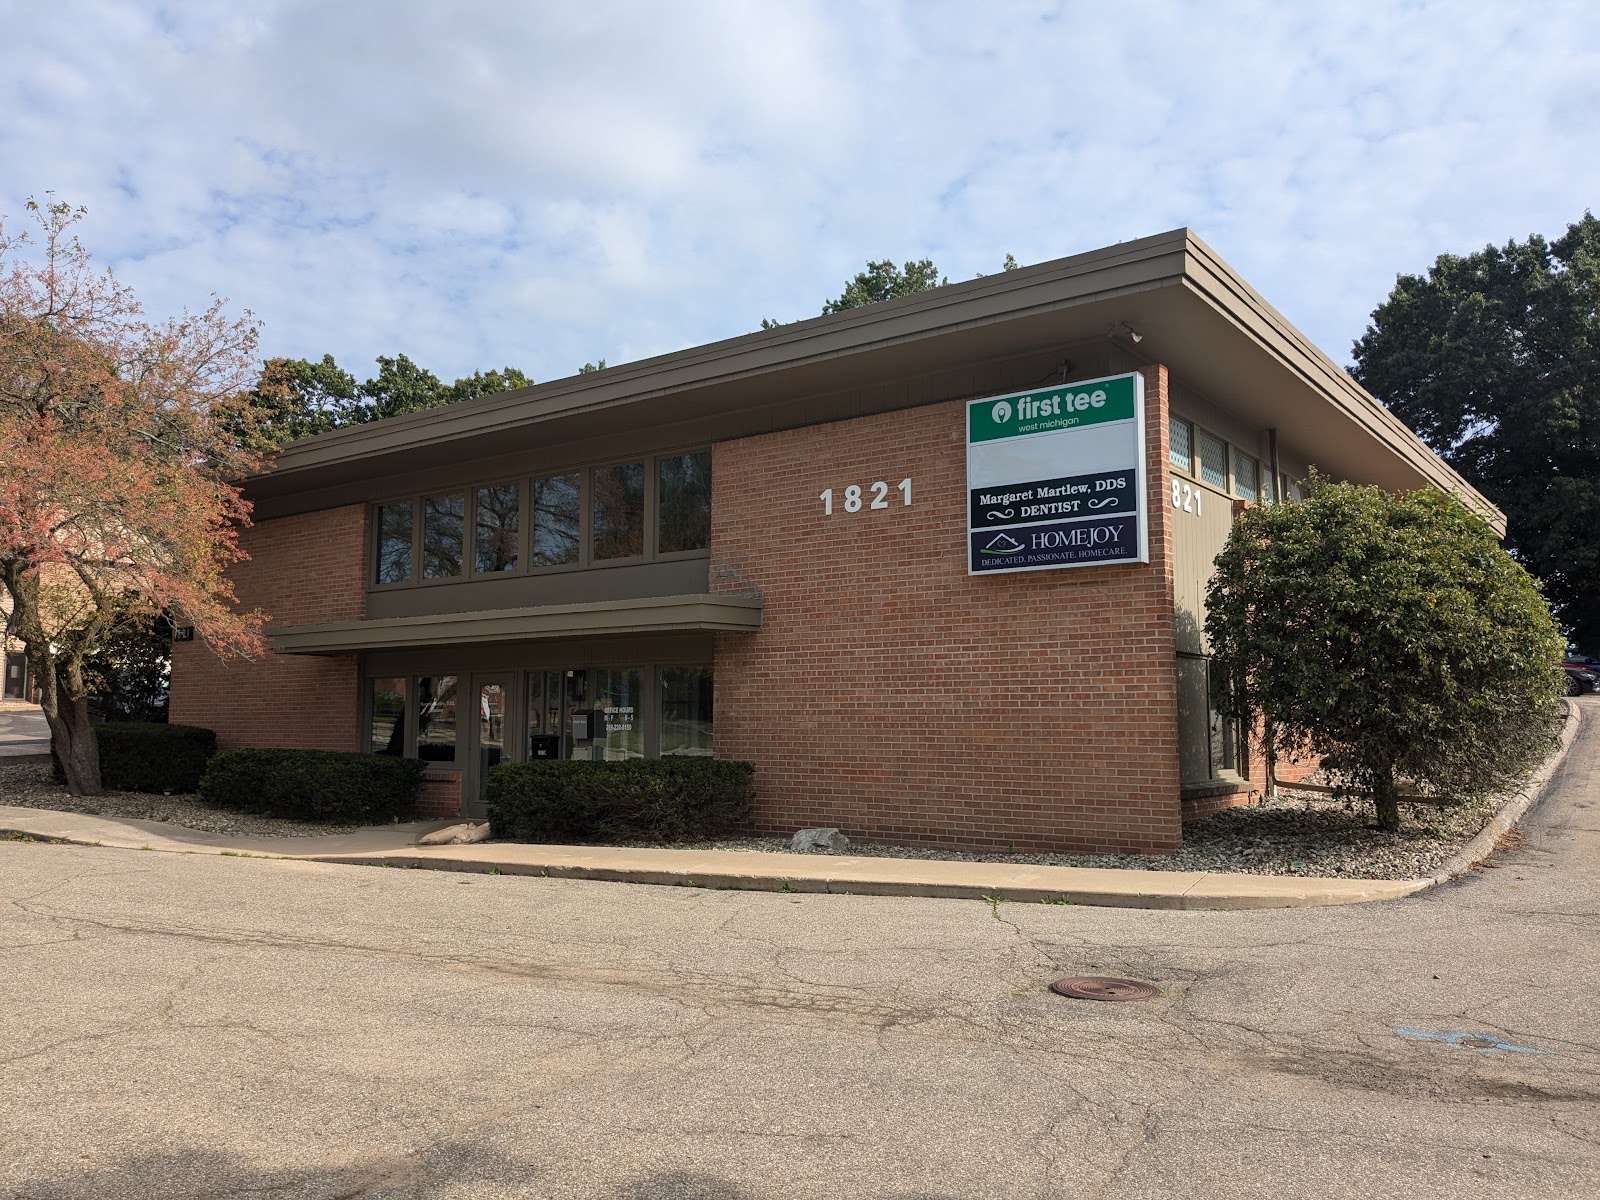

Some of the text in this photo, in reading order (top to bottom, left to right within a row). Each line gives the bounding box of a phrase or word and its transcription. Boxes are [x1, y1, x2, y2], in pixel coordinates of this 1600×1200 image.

[1017, 390, 1107, 420] first tee
[1018, 417, 1079, 432] west michigan
[819, 478, 912, 516] 1821
[980, 477, 1127, 506] Margaret Martlew, DDS
[1171, 479, 1202, 517] 821
[1020, 500, 1081, 517] DENTIST
[1030, 525, 1124, 550] HOMEJOY
[981, 546, 1128, 566] DEDICATED. PASSIONATE. HOMECARE.
